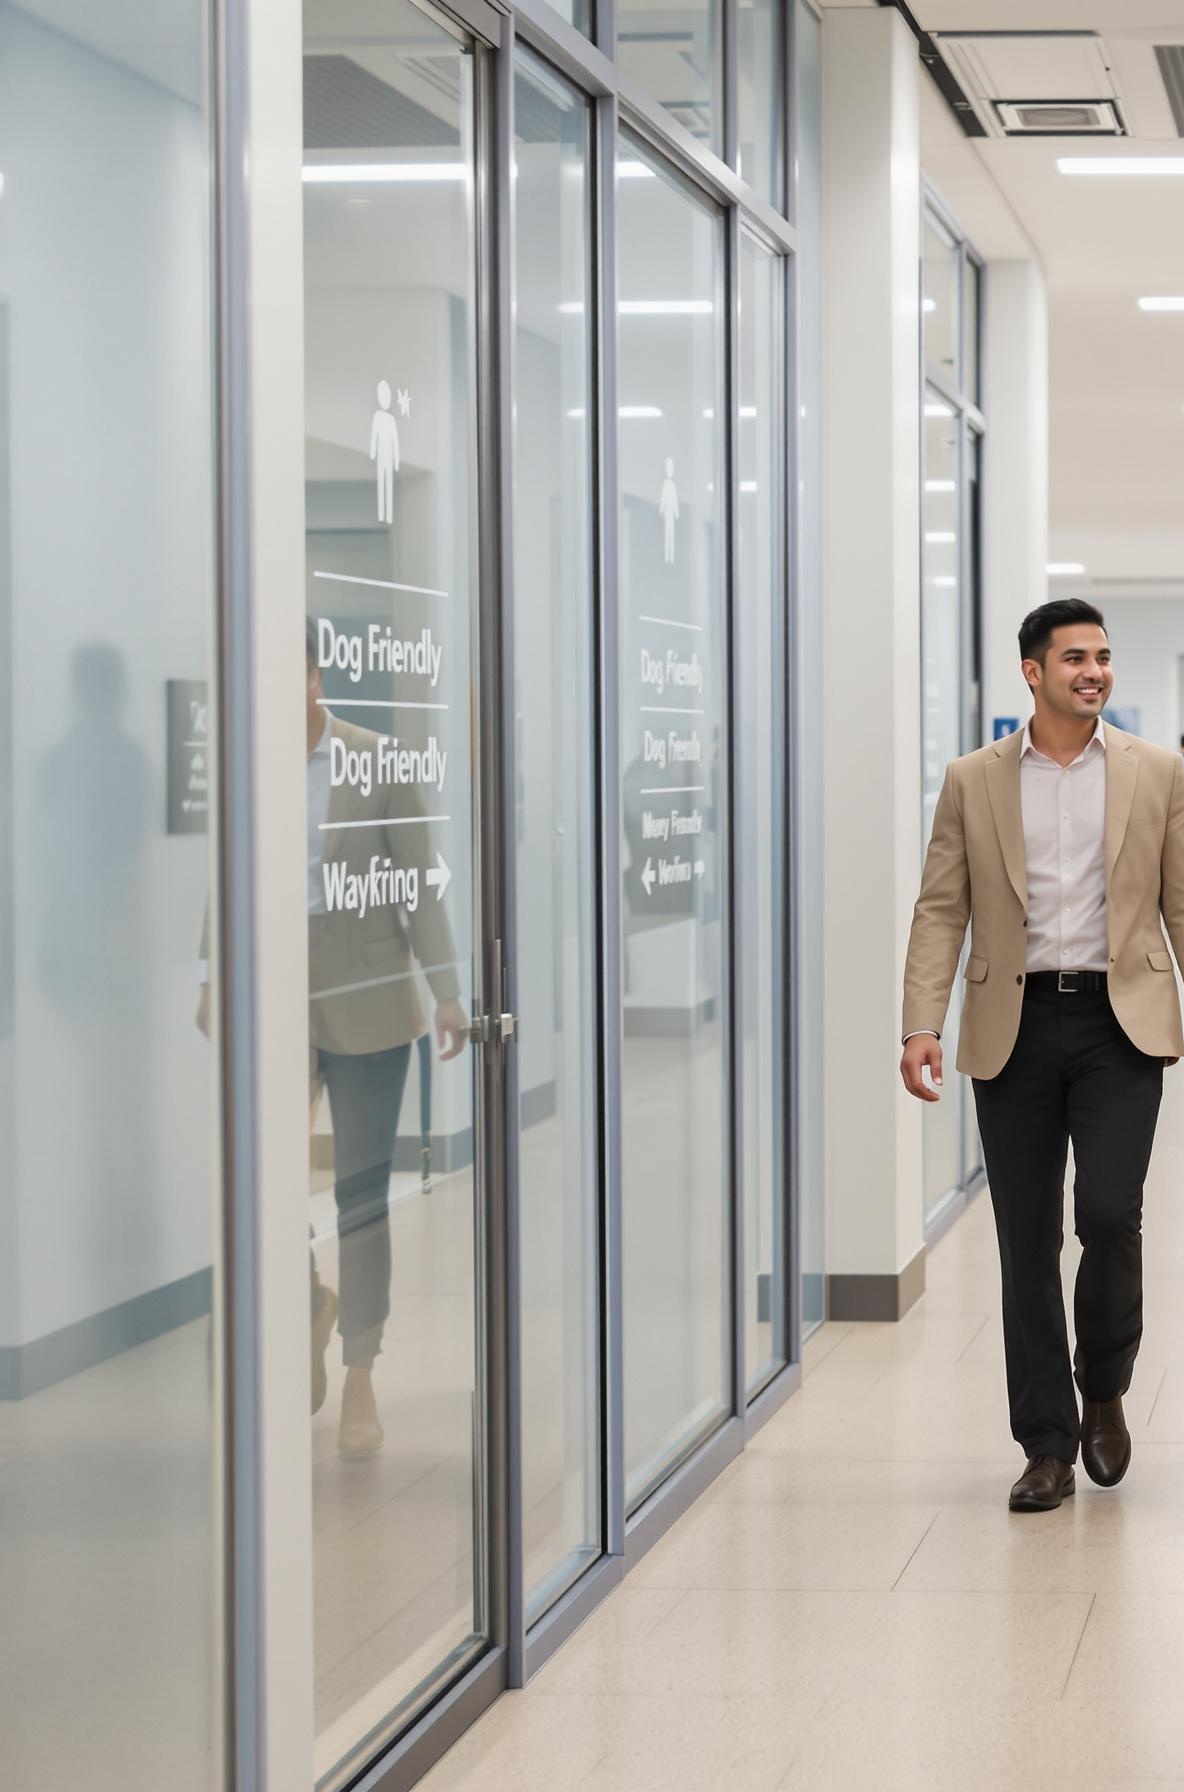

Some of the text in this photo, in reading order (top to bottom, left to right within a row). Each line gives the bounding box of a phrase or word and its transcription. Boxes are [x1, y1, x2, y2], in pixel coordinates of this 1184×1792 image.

[318, 617, 442, 687] Dog Friendly
[641, 648, 664, 695] Dog
[330, 737, 447, 797] Dog Friendly
